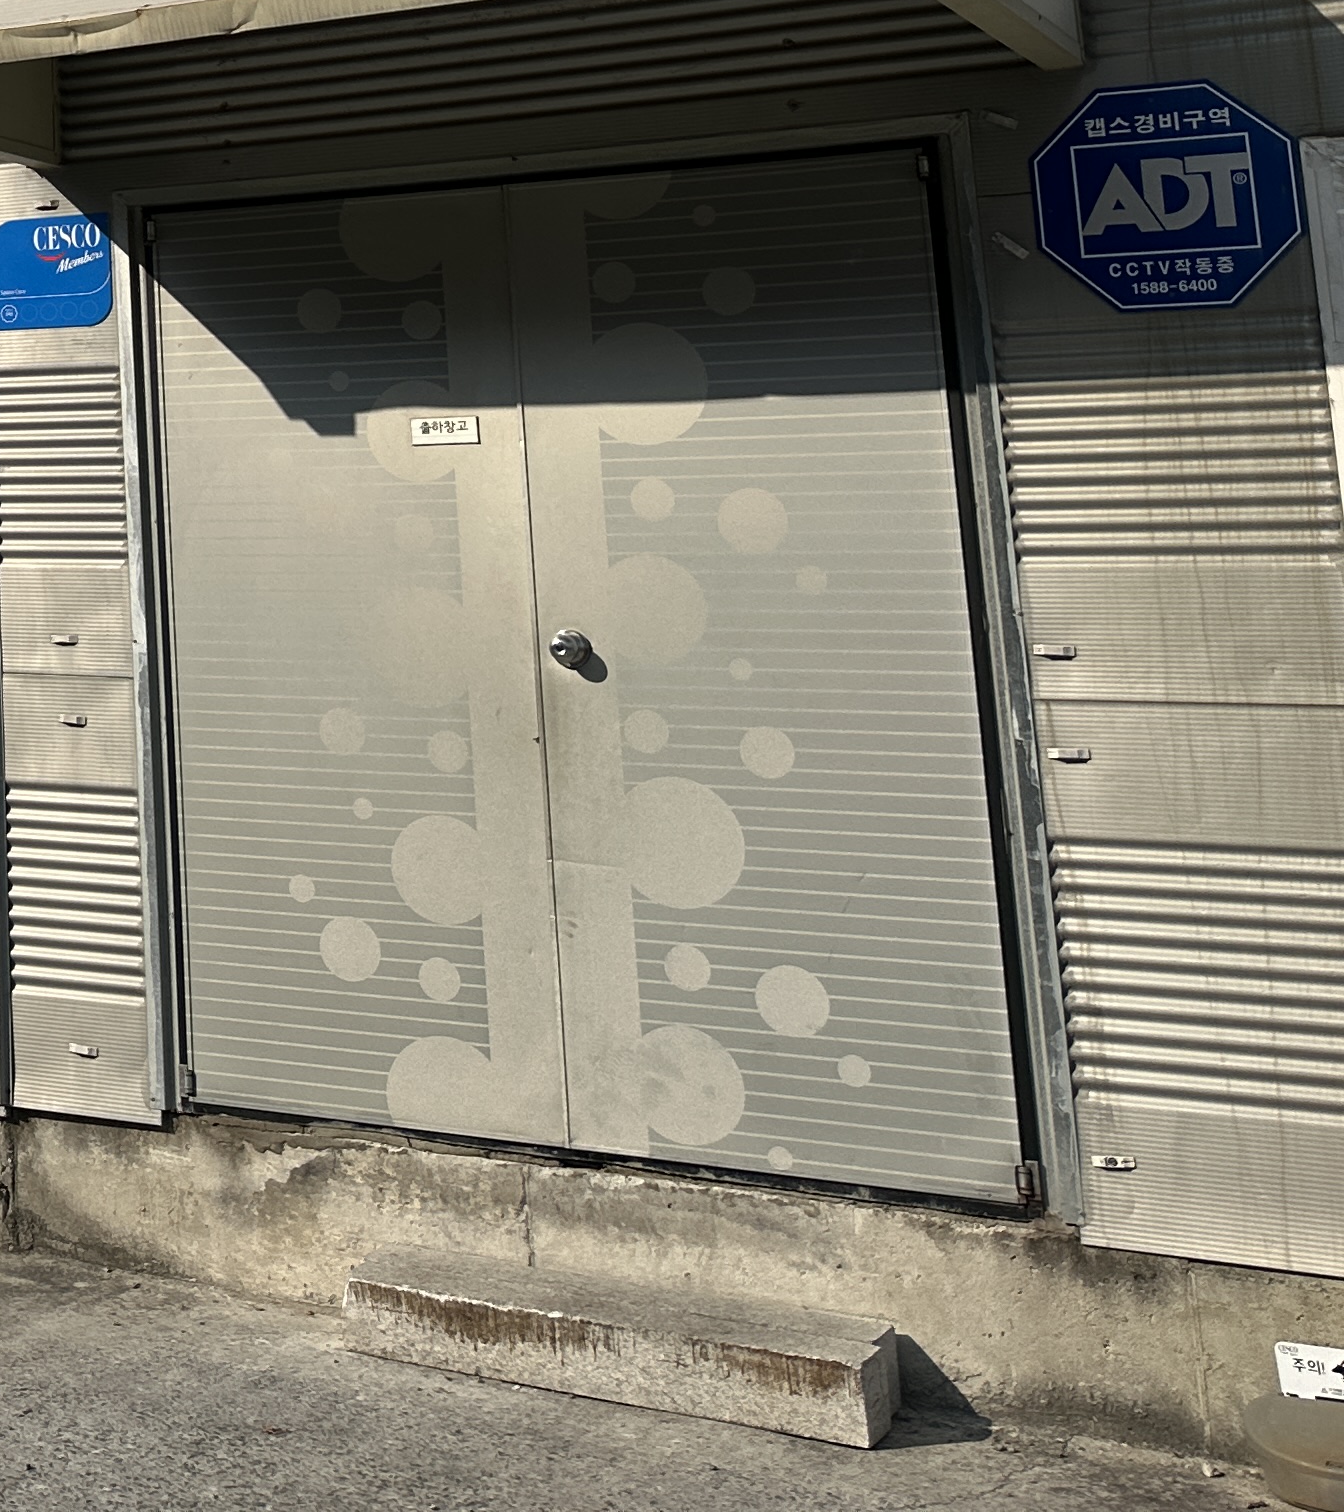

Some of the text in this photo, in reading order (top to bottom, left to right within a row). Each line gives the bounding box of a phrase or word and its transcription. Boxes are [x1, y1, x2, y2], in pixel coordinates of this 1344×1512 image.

[1084, 106, 1231, 138] 캡스경비구역
[1081, 151, 1250, 236] ADT
[33, 222, 101, 251] CESCO
[55, 249, 104, 275] Members
[1131, 278, 1218, 295] 1588-6400
[1292, 1357, 1326, 1375] 주의!
